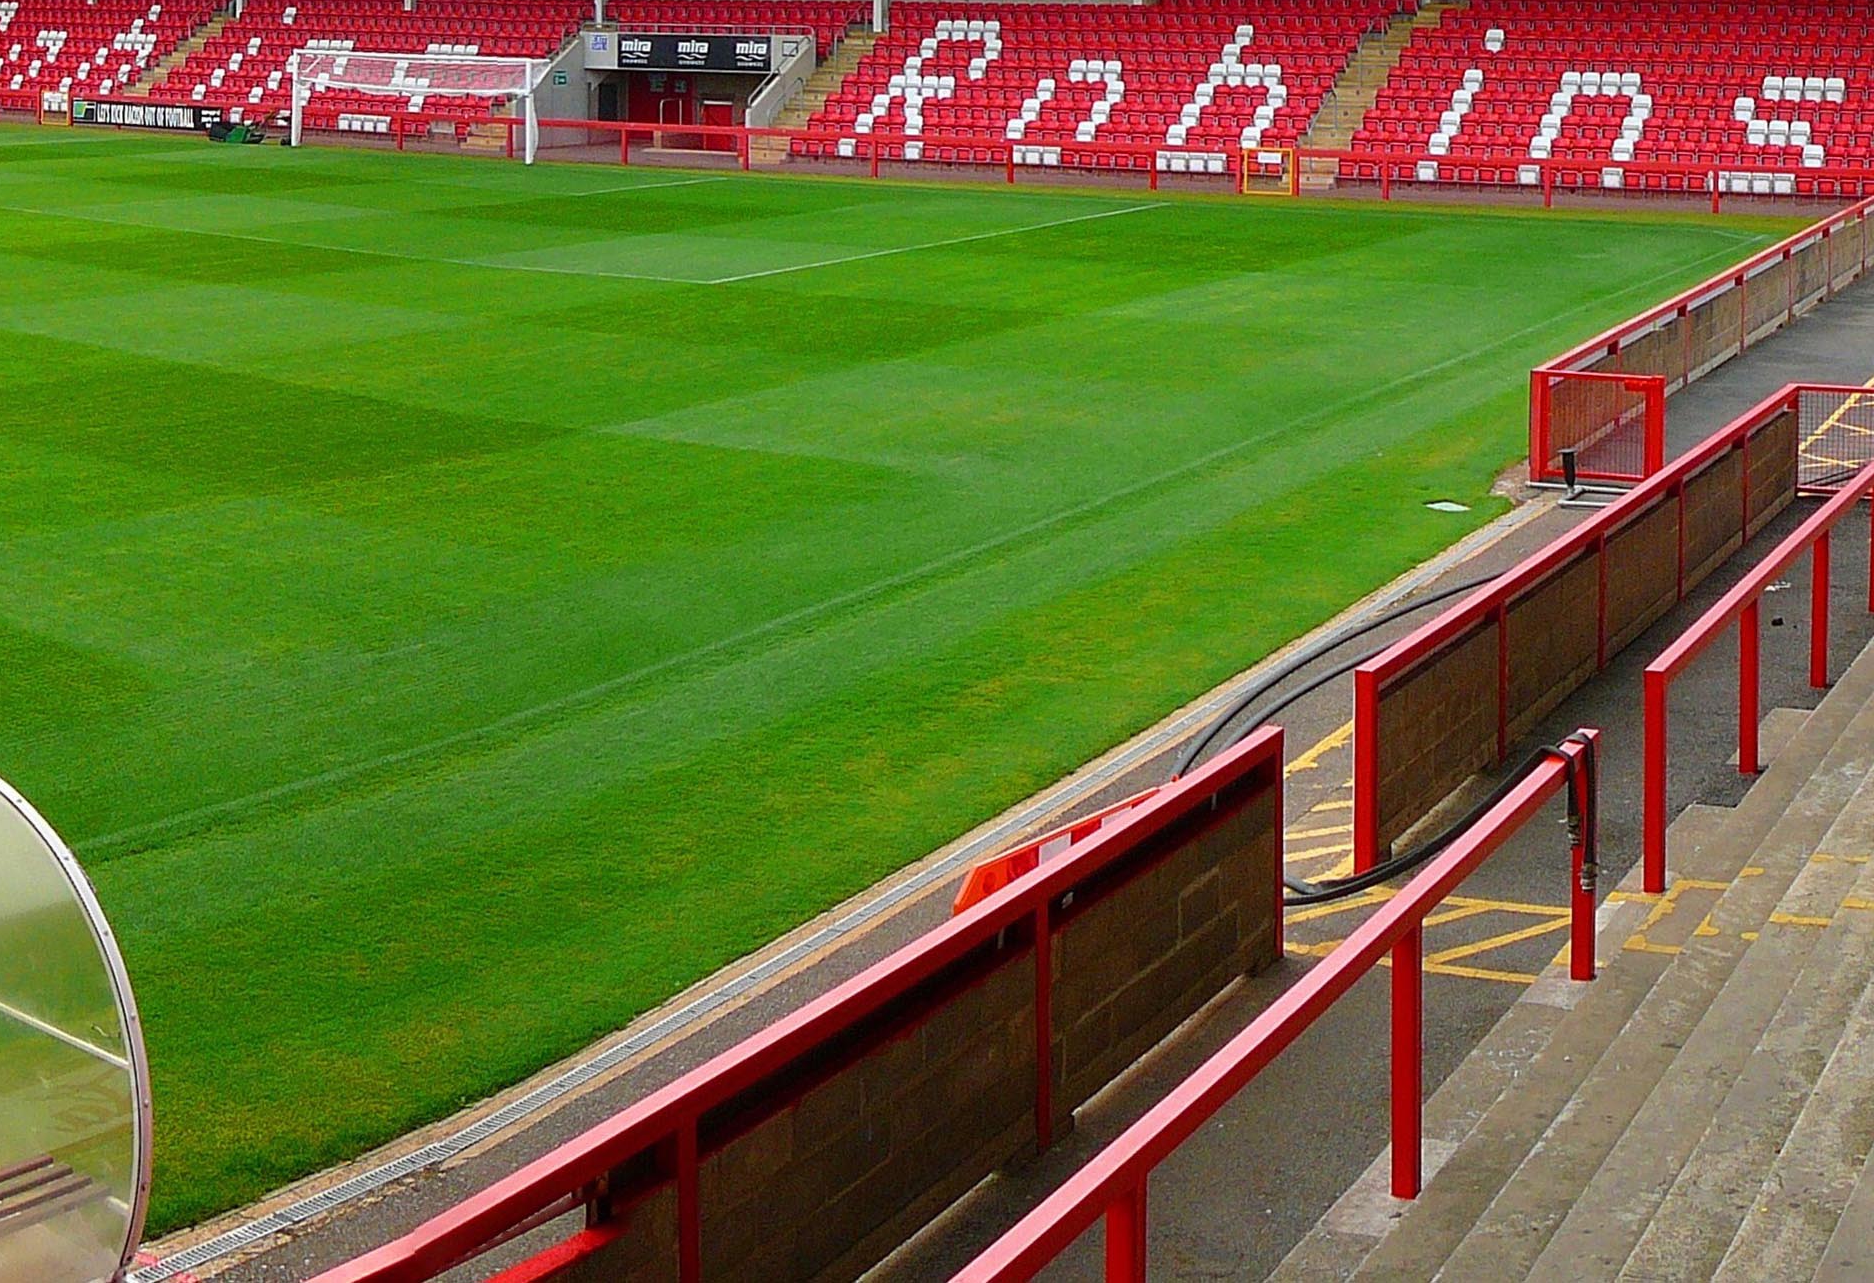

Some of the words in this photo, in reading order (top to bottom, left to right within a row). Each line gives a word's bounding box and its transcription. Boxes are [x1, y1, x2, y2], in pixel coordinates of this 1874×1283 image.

[621, 38, 651, 52] mira
[678, 39, 708, 53] mira
[736, 40, 766, 54] mira
[837, 20, 1846, 193] Robins
[145, 106, 155, 126] OUT
[156, 106, 164, 126] OF
[165, 107, 194, 128] FOOTBALL
